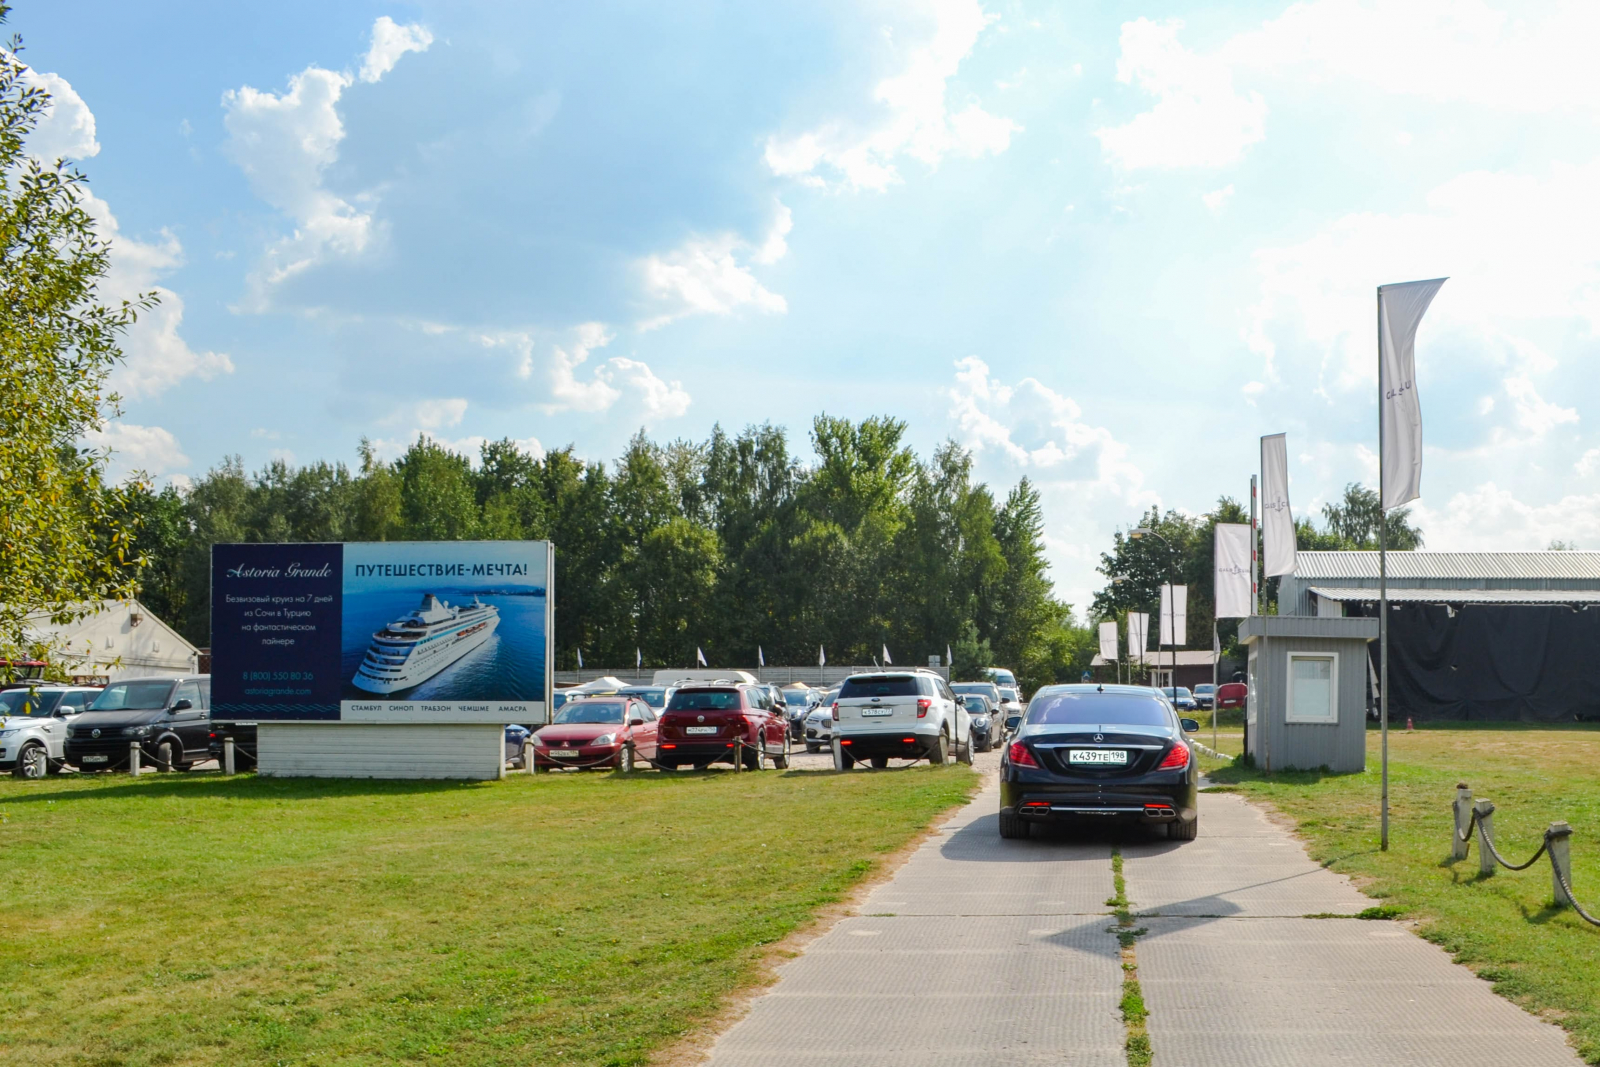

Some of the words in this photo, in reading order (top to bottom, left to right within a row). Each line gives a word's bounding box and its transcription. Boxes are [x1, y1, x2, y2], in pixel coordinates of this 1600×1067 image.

[226, 562, 281, 578] Astoria
[284, 562, 333, 578] Grande
[355, 563, 528, 577] ПУТЕШЕСТВИЕ-МЕЧТА!
[225, 593, 271, 604] Безвизовый
[272, 595, 294, 605] круиз
[295, 595, 305, 603] на
[307, 593, 313, 604] 7
[313, 594, 333, 604] дней
[254, 607, 276, 618] Сочи
[283, 608, 312, 619] Турцию
[252, 622, 316, 633] фантастическом
[261, 637, 295, 647] лайнере
[242, 671, 248, 680] 8
[250, 671, 271, 681] (800)
[273, 671, 289, 680] 550
[290, 671, 302, 680] 80
[303, 671, 314, 680] 36
[244, 686, 312, 697] astoriagrande.com
[351, 704, 382, 712] СТАМБУЛ
[388, 704, 414, 712] СИНОП
[420, 704, 452, 712] ТРАБЗОН
